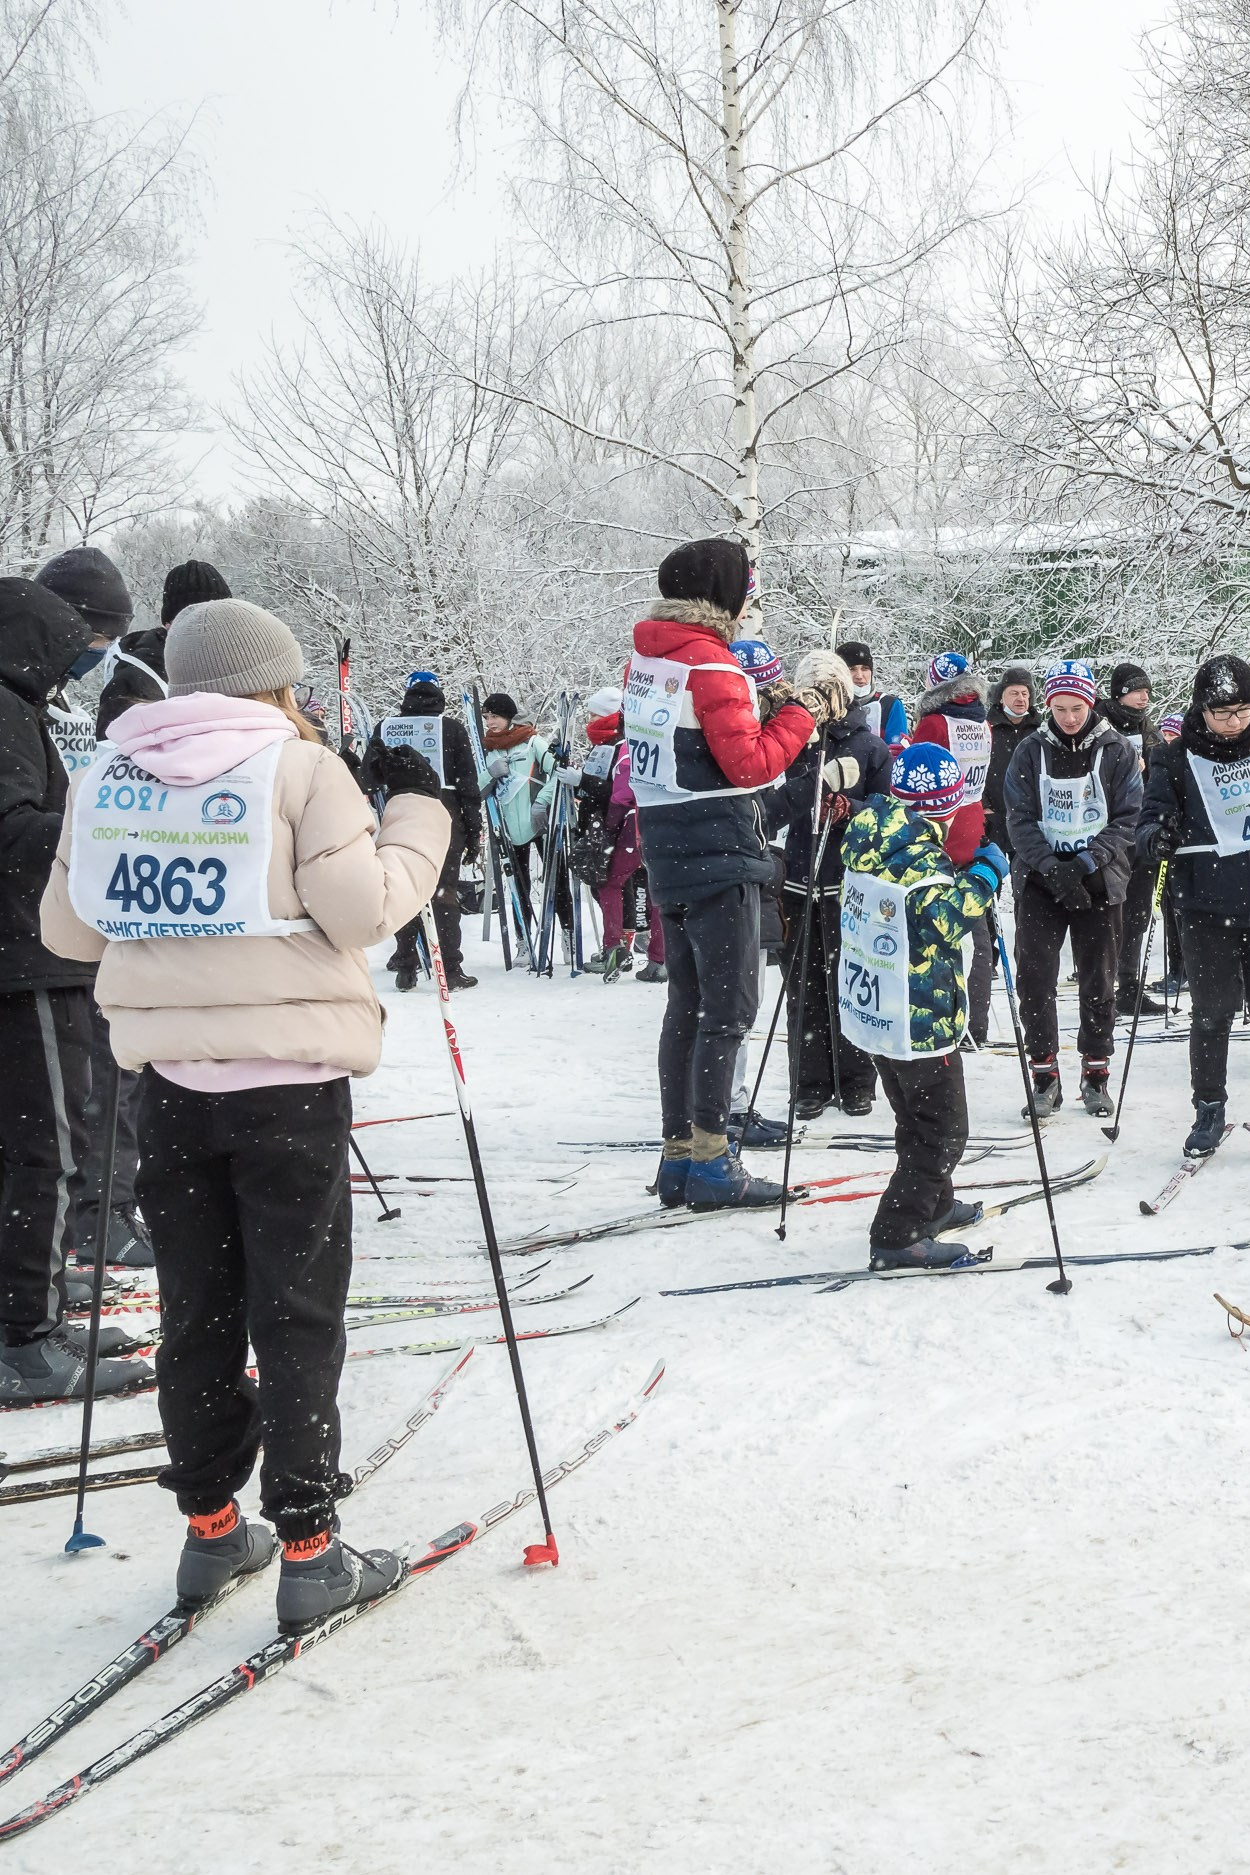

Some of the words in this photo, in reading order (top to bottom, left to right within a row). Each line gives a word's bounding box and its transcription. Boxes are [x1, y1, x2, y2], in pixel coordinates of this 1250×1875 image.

[343, 677, 351, 734] Quecua
[626, 737, 660, 778] 791
[94, 785, 169, 811] 2021
[1047, 808, 1071, 823] 2021
[1225, 803, 1246, 815] СПОРТ
[92, 827, 128, 841] СПОРТ
[140, 829, 190, 844] НОРМА
[192, 832, 249, 845] ЖИЗНИ
[105, 853, 227, 915] 4863
[1155, 864, 1168, 908] LARSEN
[97, 919, 245, 938] САНКТ-ПЕТЕРБУРГ
[845, 959, 880, 1012] 751
[354, 1408, 434, 1487] ABLE
[481, 1430, 613, 1527] SABLE
[301, 1601, 369, 1654] SABLE
[26, 1645, 138, 1748] SPORT
